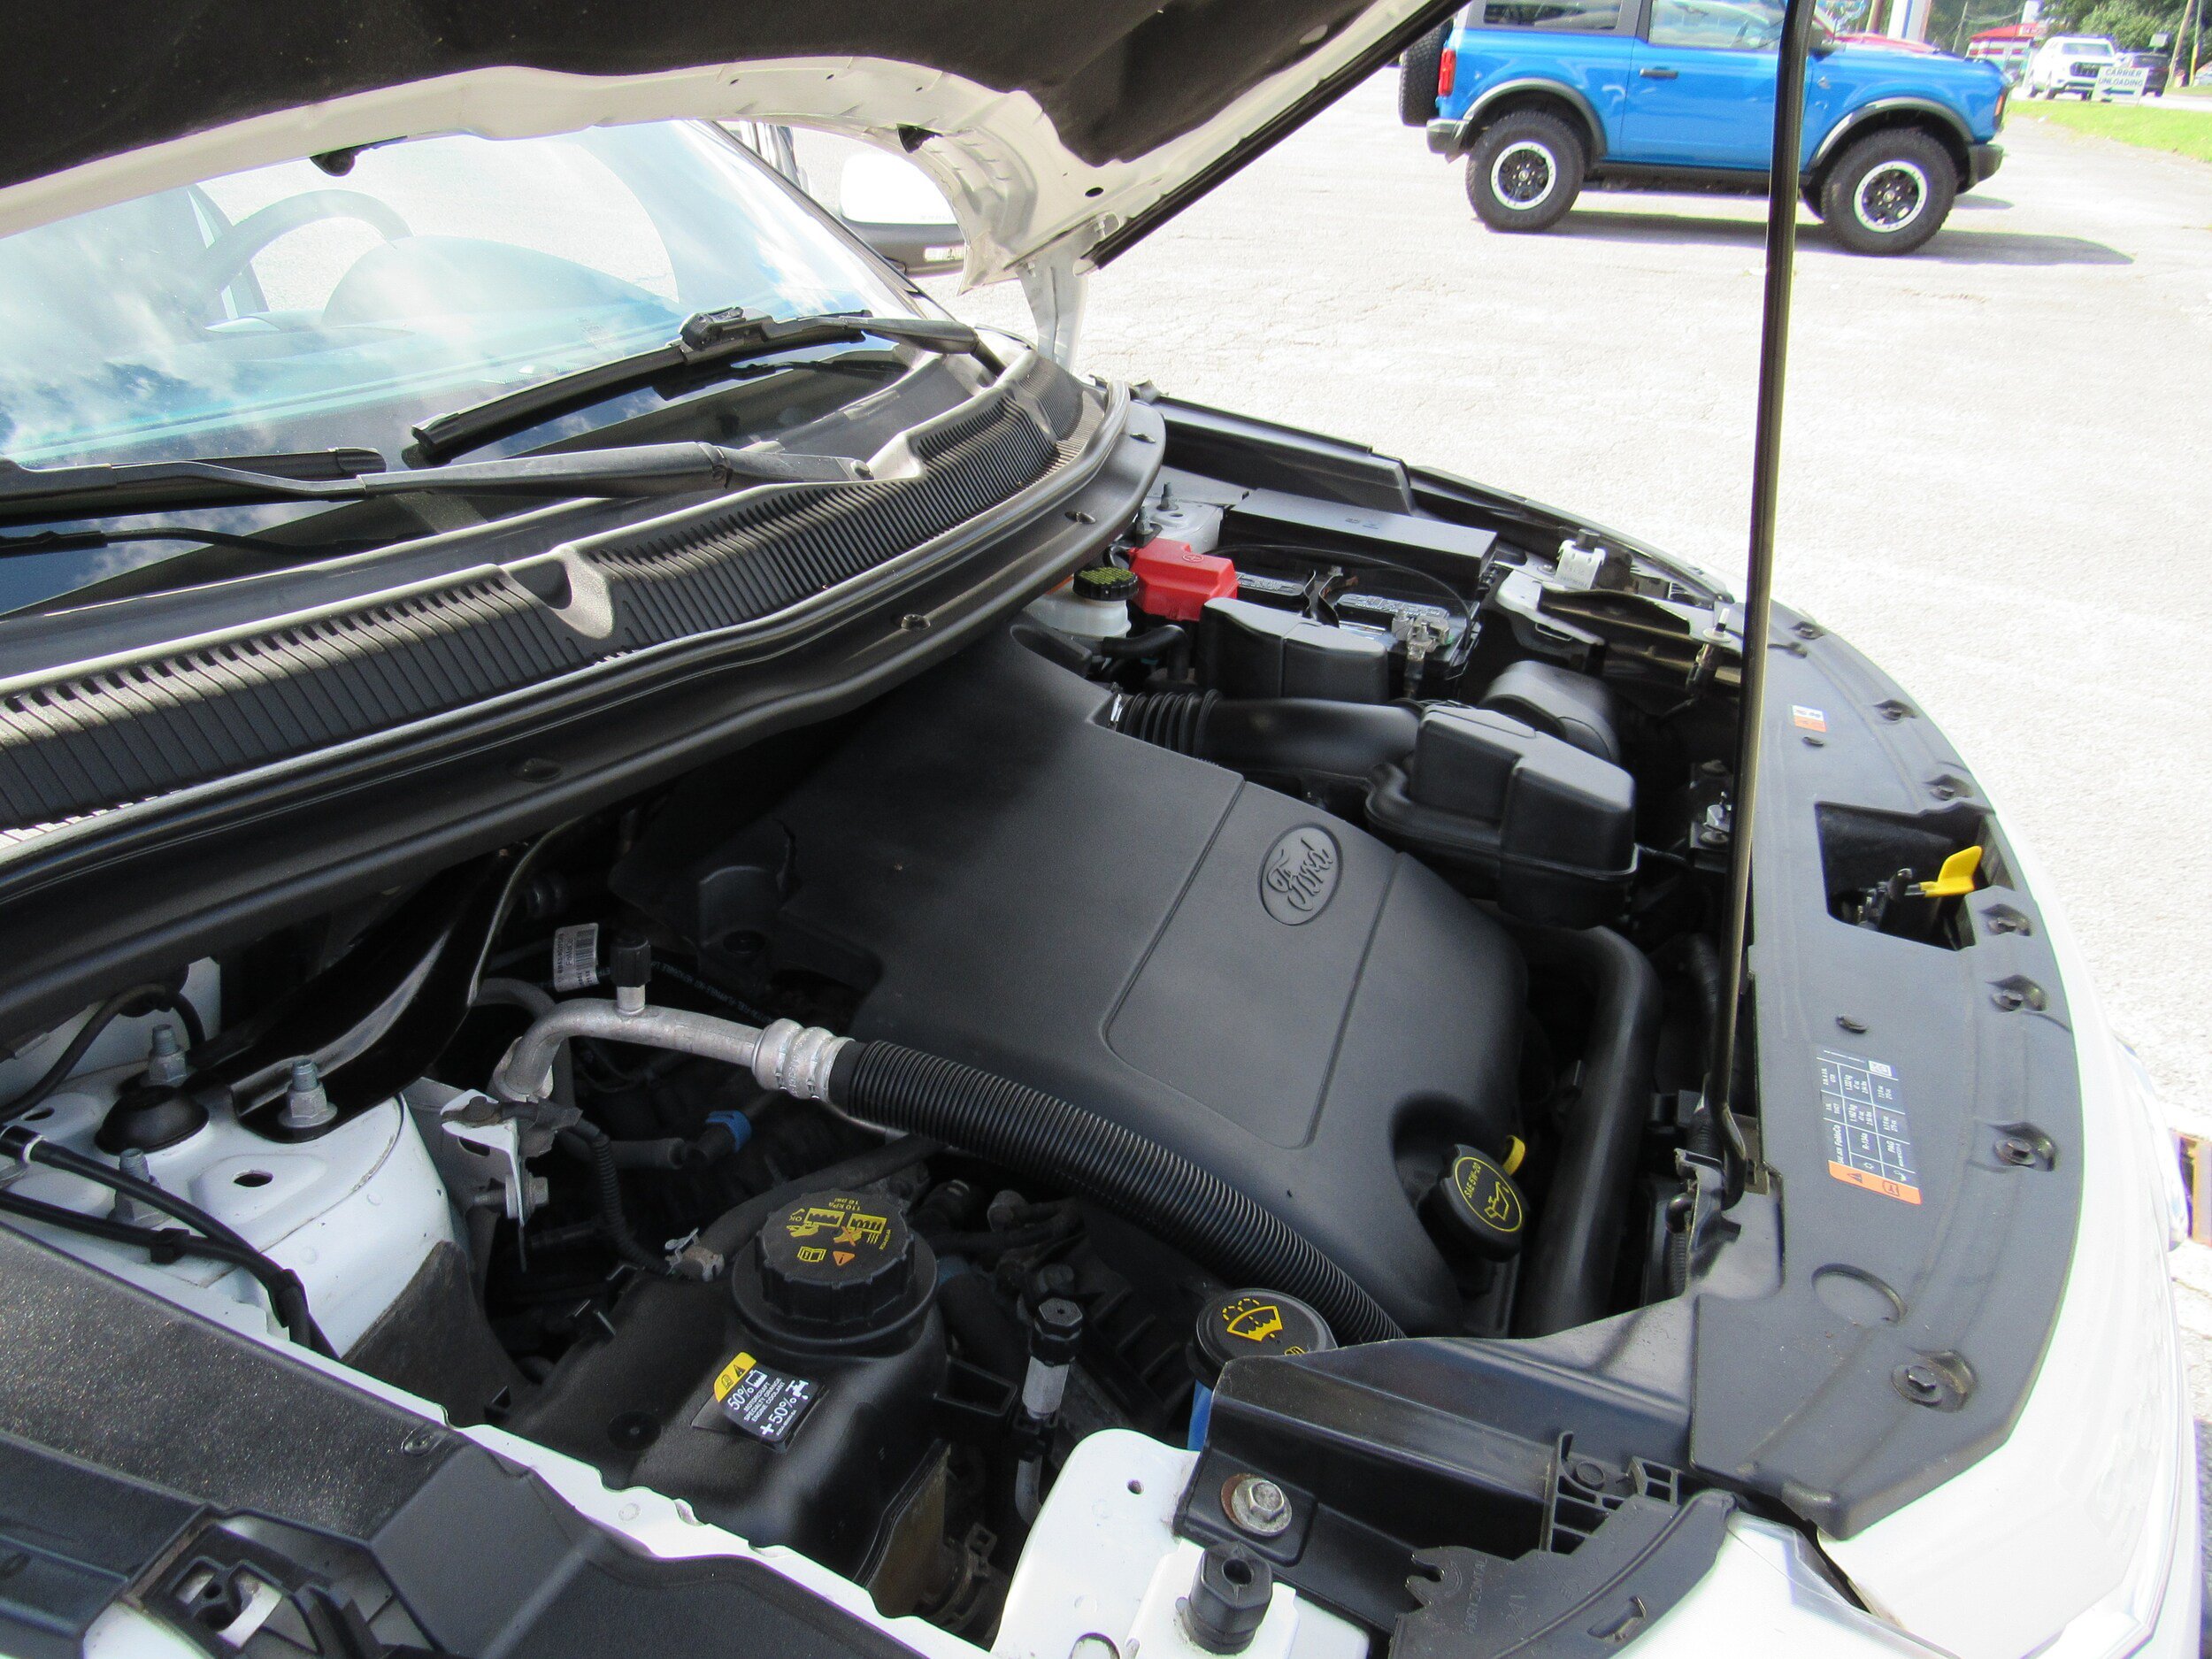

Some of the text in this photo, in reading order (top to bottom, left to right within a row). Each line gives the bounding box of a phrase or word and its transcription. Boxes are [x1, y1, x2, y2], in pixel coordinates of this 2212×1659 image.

[2098, 78, 2143, 87] UNLOADING
[2105, 68, 2143, 77] CARRIER
[1266, 837, 1333, 911] Ford
[1859, 1132, 1869, 1149] R-134a
[1886, 1140, 1895, 1153] PAG
[1464, 1162, 1481, 1199] SAE 5W-20
[727, 1385, 755, 1410] 50%
[743, 1382, 771, 1412] MOTORCRAFT
[743, 1377, 782, 1422] SPECIALTY ORANGE
[751, 1382, 786, 1422] ENGINE COOLANT
